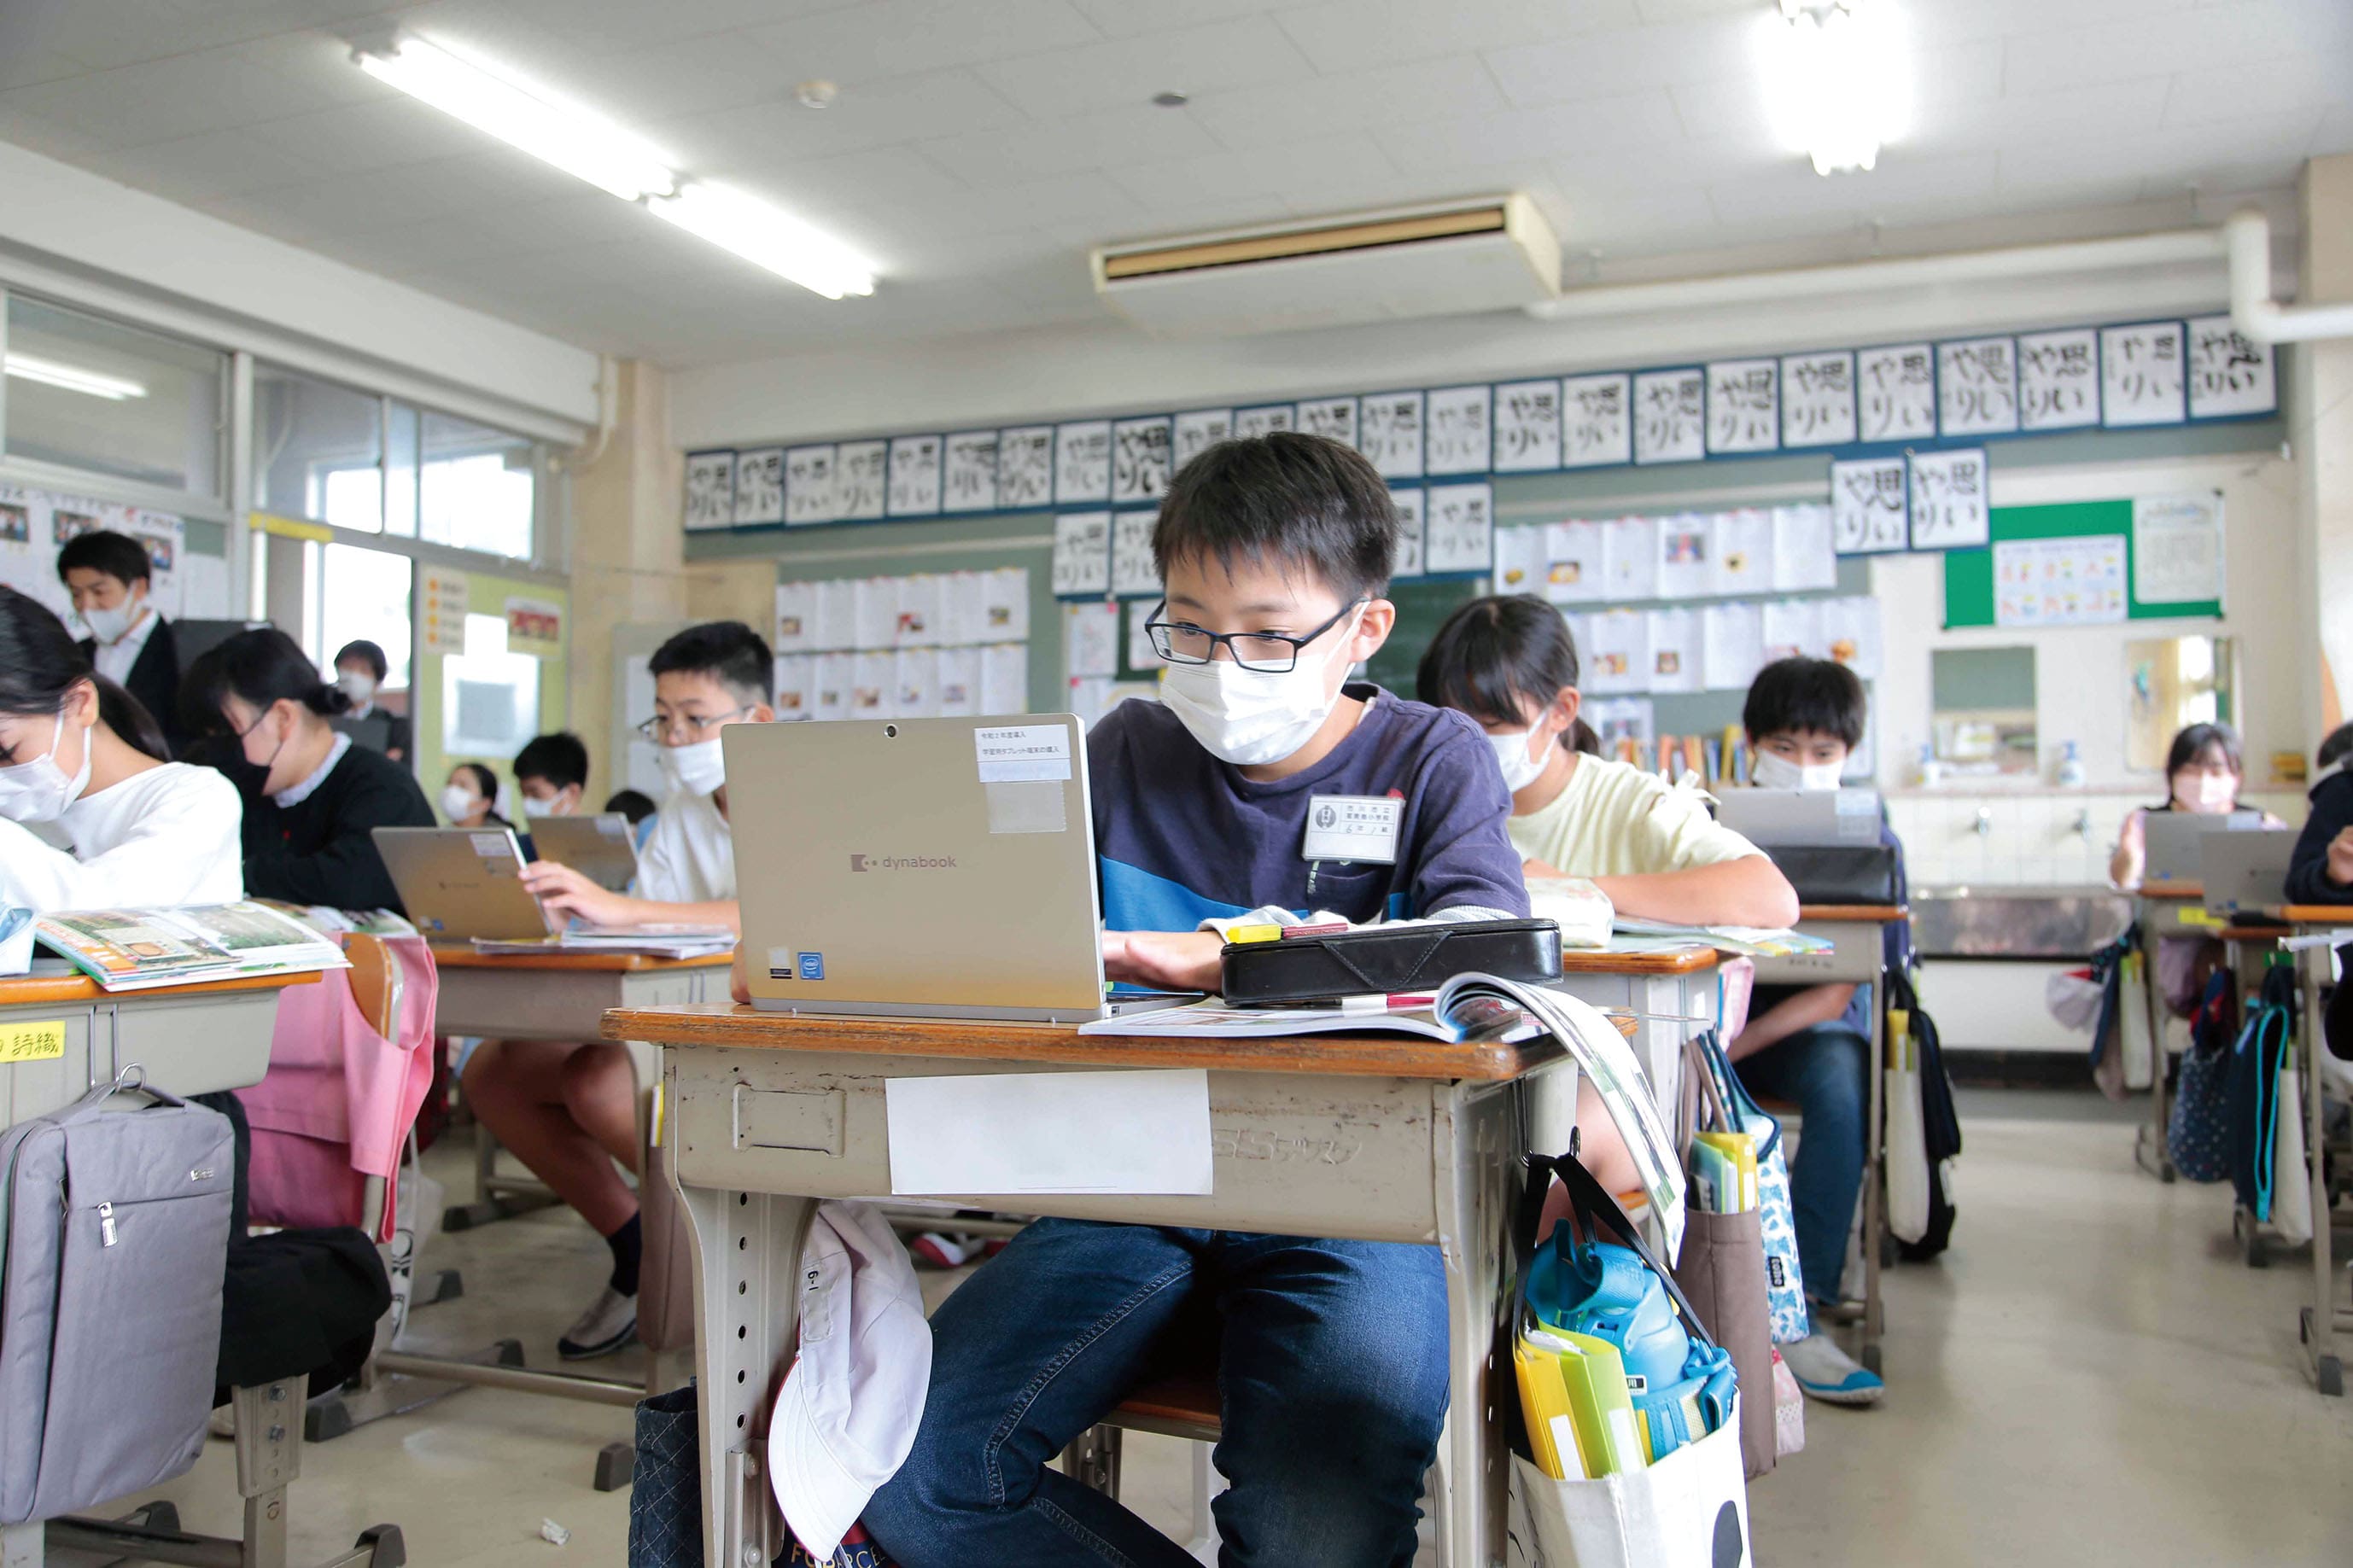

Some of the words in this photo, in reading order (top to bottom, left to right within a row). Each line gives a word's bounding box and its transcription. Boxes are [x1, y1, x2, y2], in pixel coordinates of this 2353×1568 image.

[1819, 359, 1850, 424] 思い
[1901, 354, 1933, 428] 思い
[1977, 345, 2013, 421] 思い
[2052, 344, 2089, 414] 思い
[1866, 469, 1902, 542] 思い
[1944, 463, 1978, 528] 思い
[883, 854, 957, 871] dynabook
